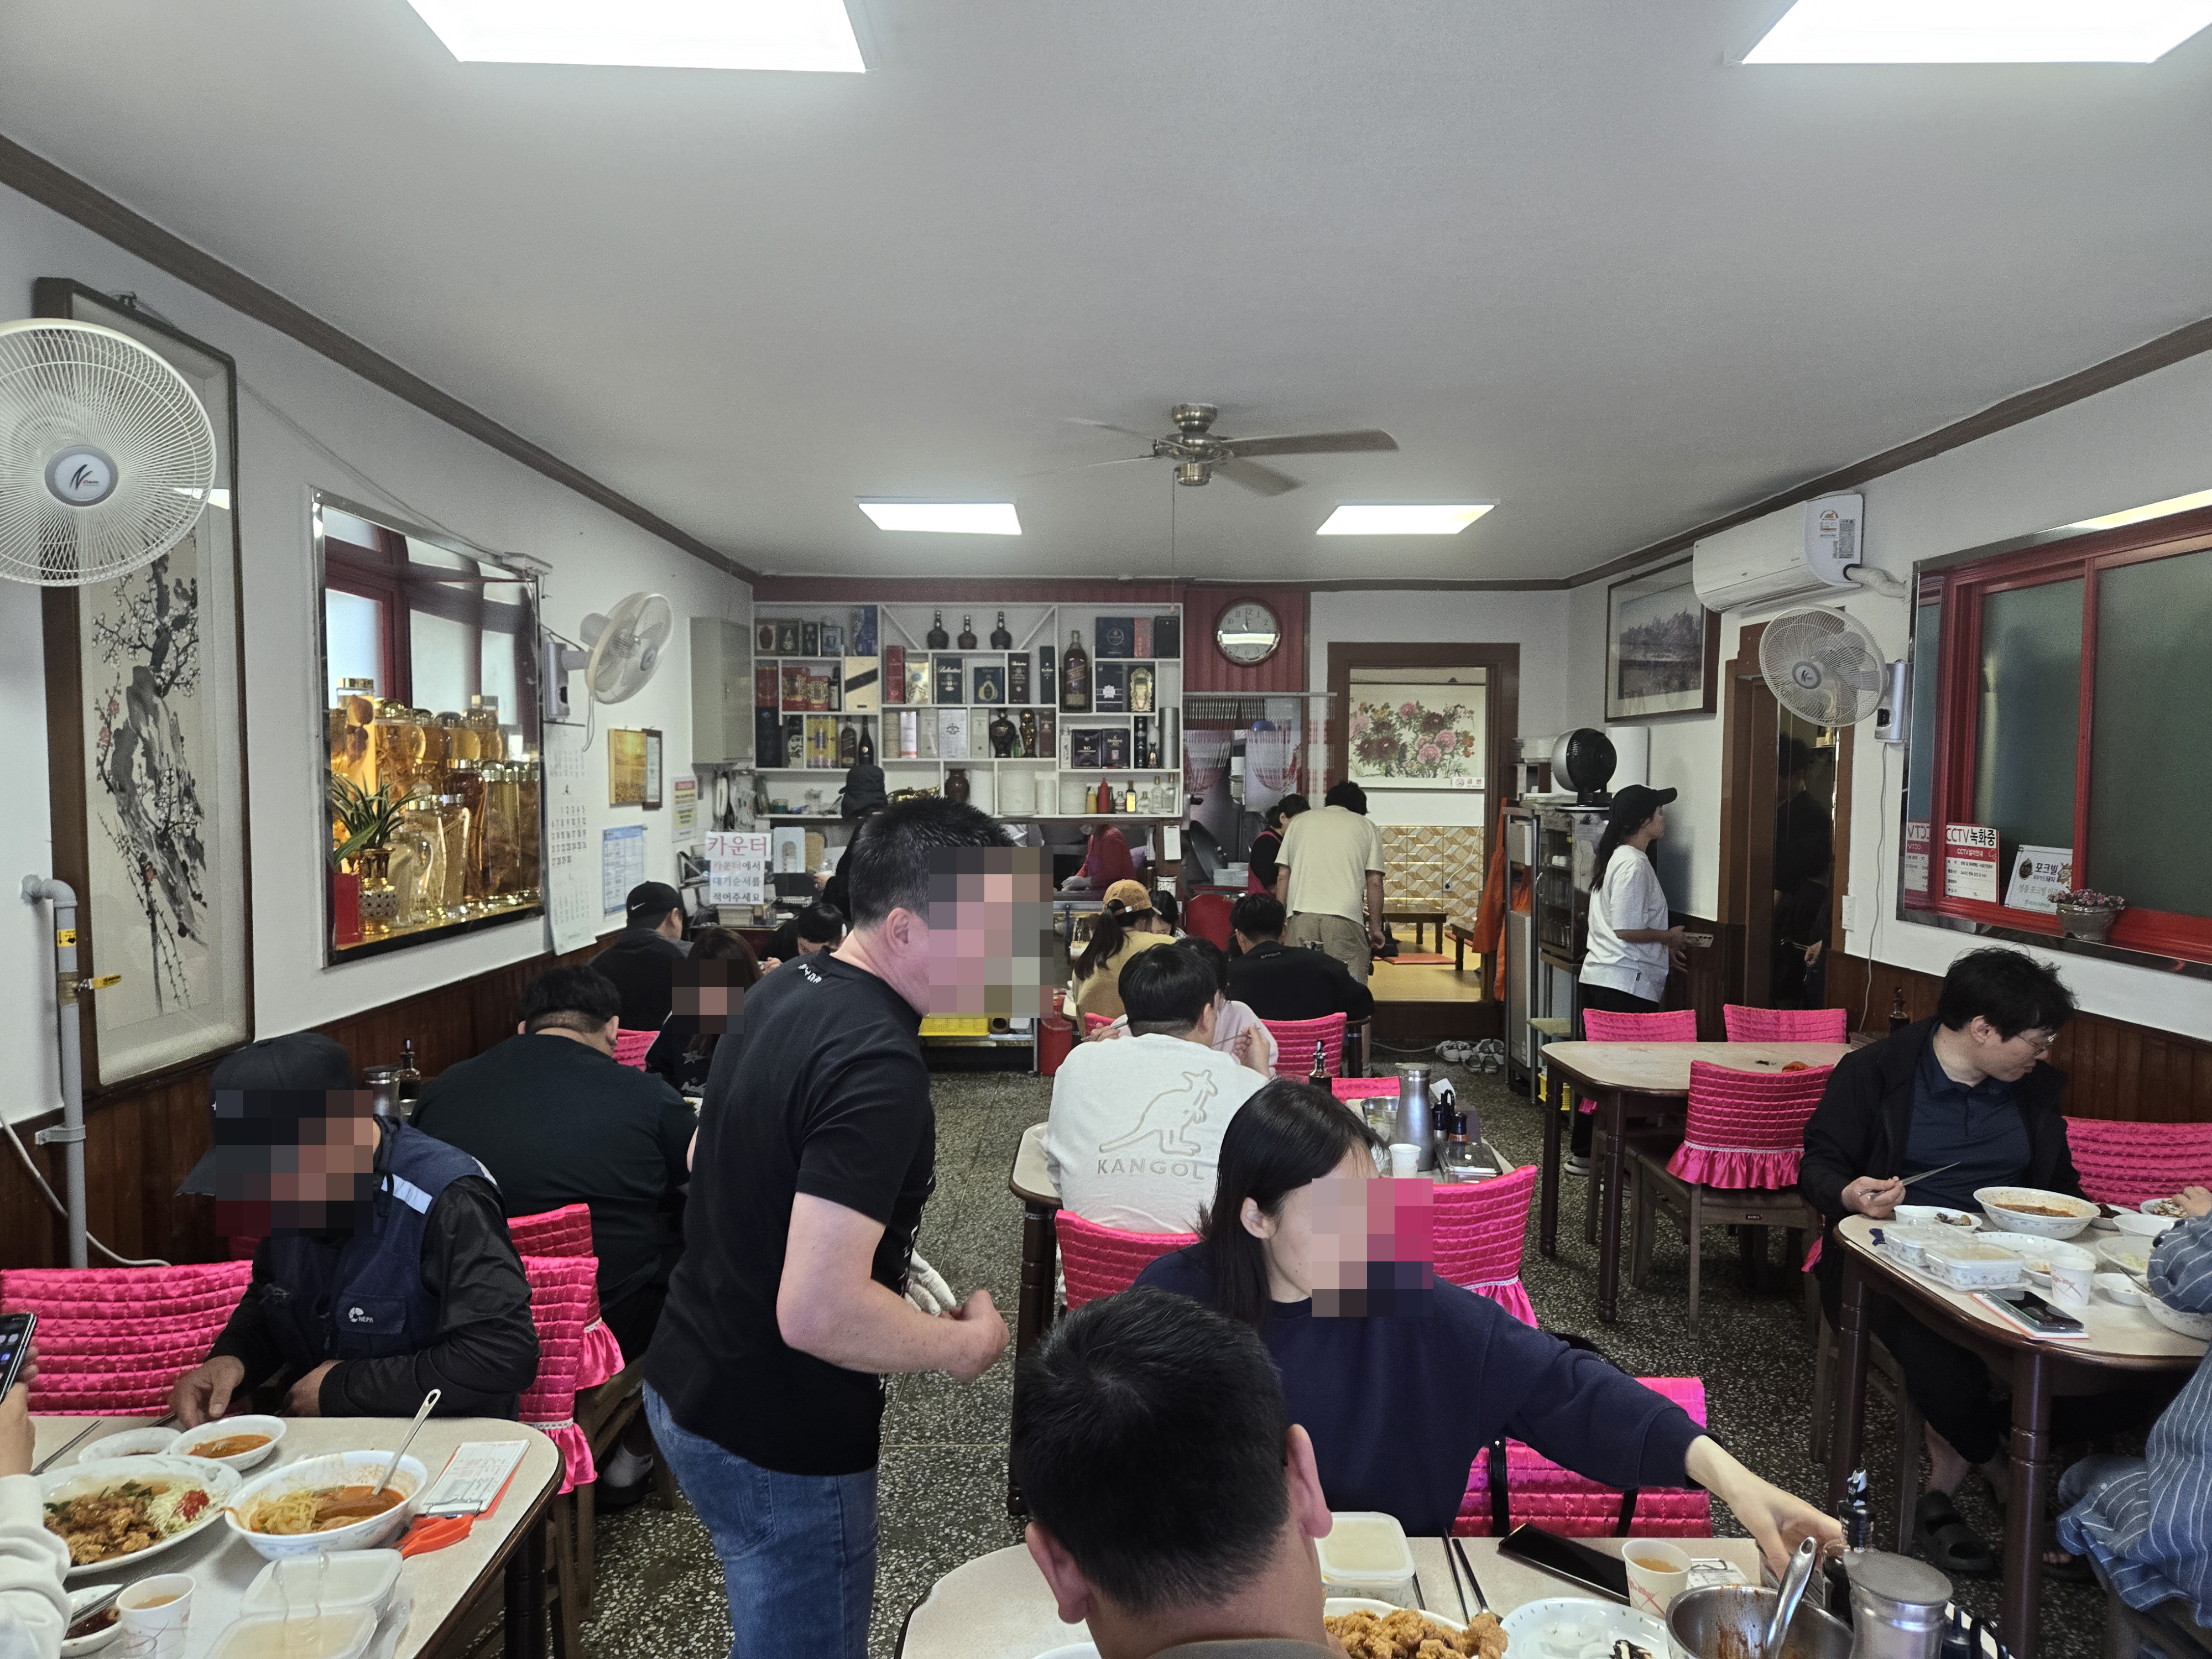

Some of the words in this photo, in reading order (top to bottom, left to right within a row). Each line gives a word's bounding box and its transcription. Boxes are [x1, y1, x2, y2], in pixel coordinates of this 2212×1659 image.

[1970, 828, 1995, 846] 녹화중
[708, 836, 767, 856] 카운터
[713, 862, 760, 871] 카운터에서
[2034, 863, 2058, 875] 포크빌
[713, 878, 761, 887] 대기순서를
[713, 893, 760, 902] 적어주세요
[1097, 1159, 1204, 1179] KANGOL
